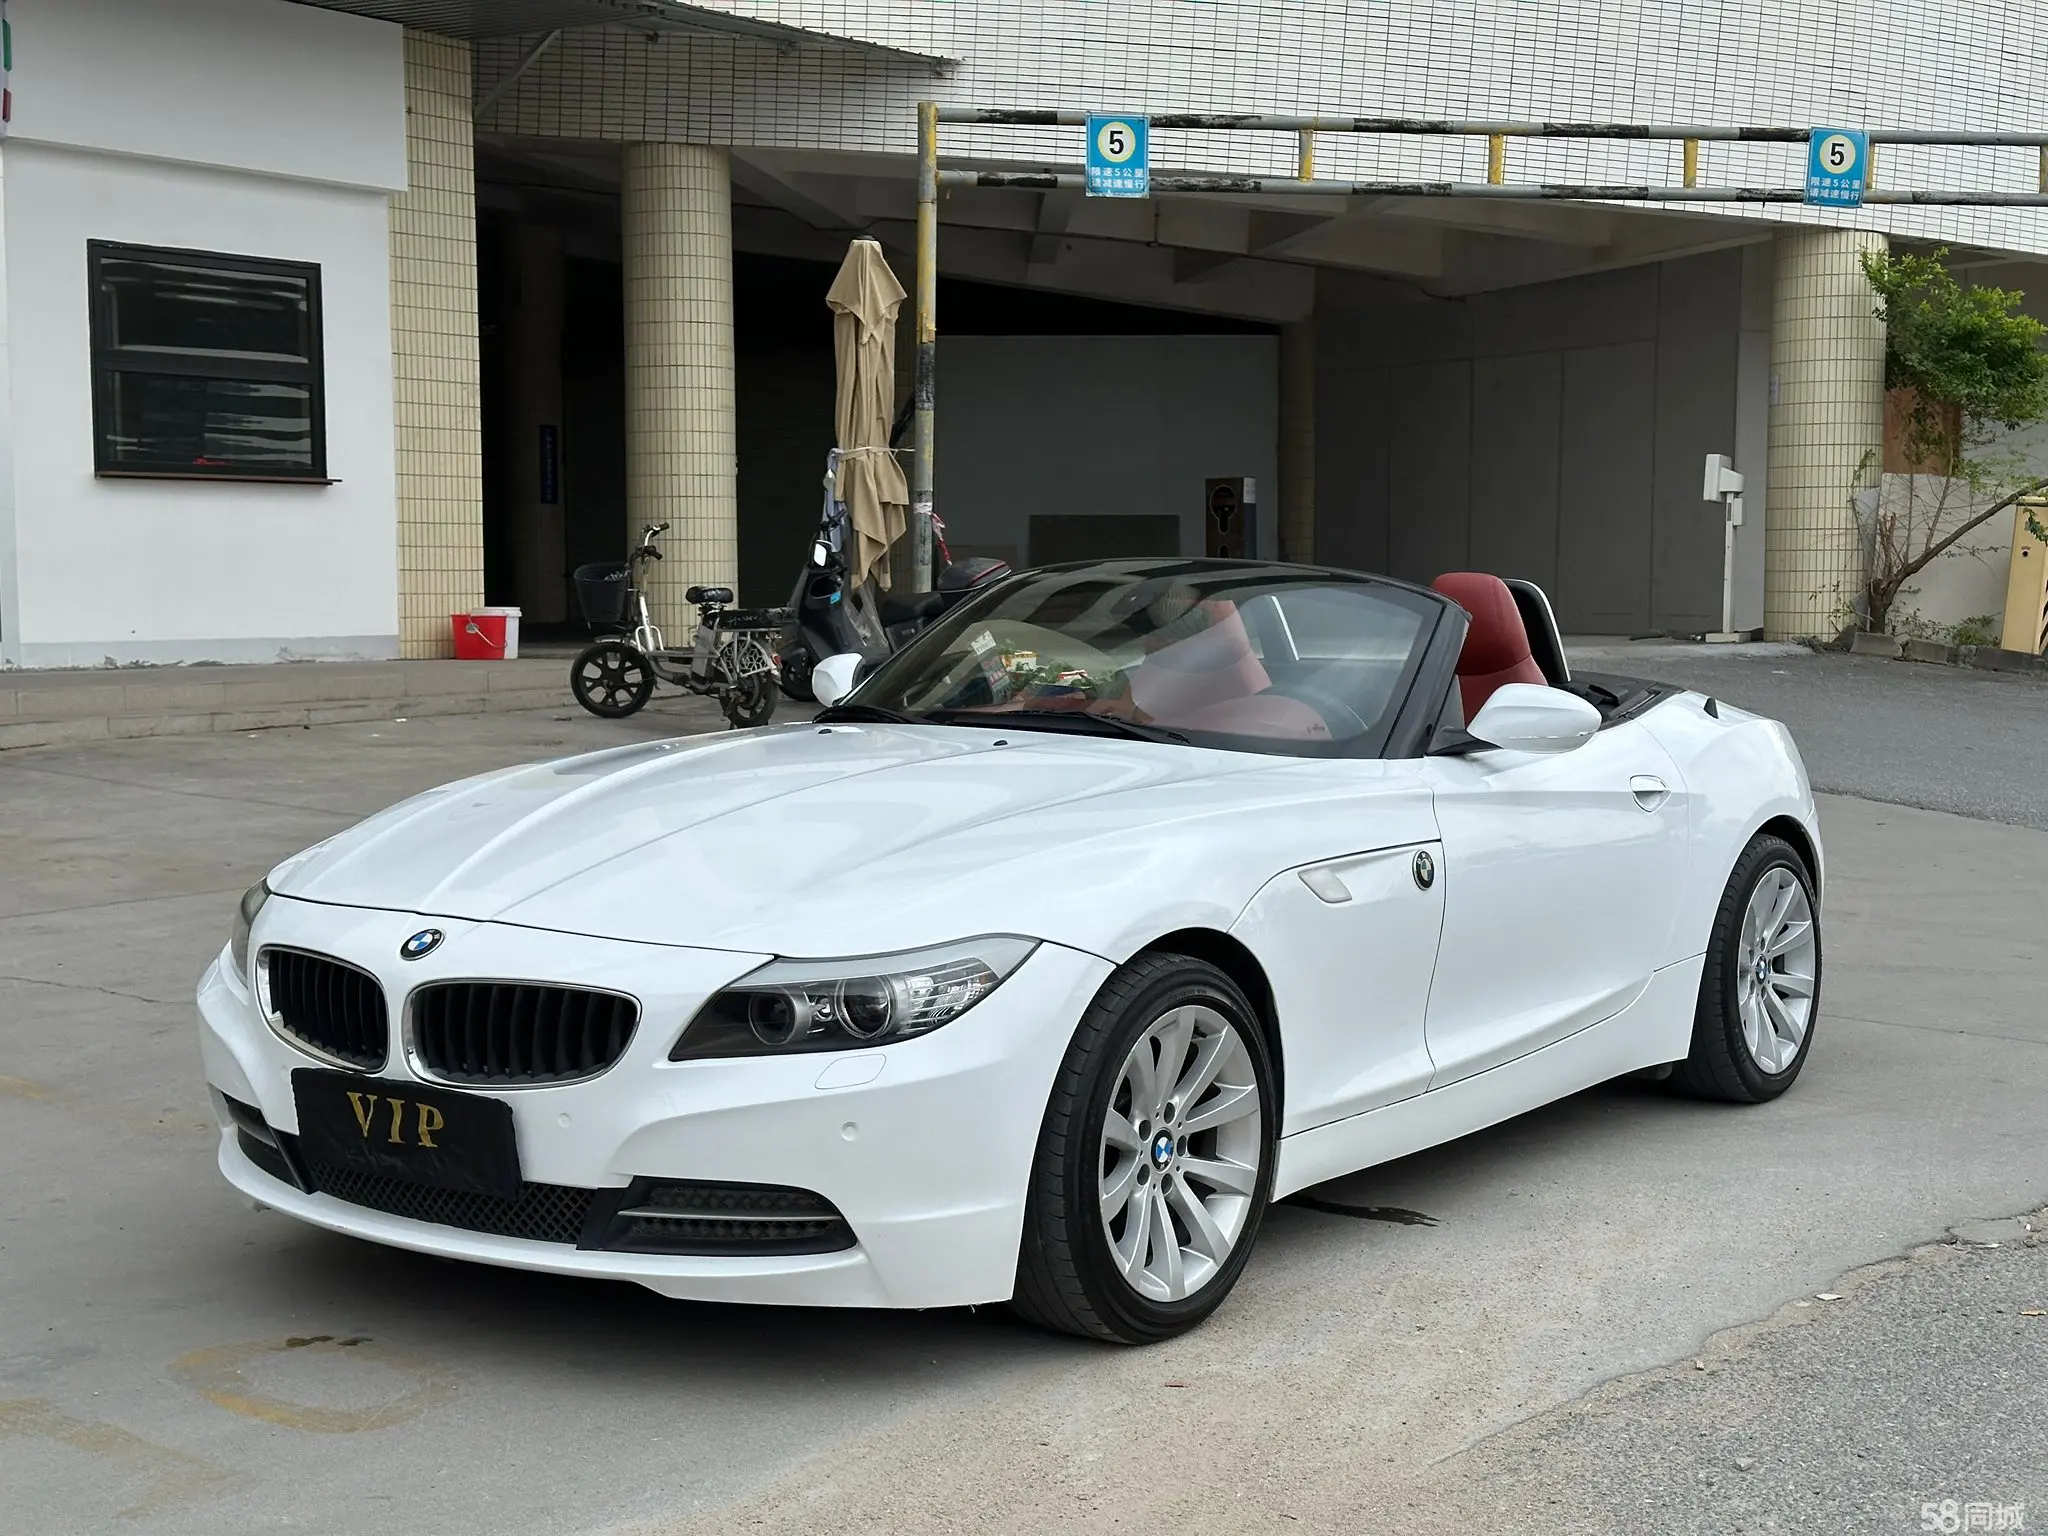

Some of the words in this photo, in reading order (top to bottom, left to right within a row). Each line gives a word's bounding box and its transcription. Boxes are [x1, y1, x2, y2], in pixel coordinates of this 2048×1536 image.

[1109, 130, 1124, 155] 5
[1830, 142, 1845, 166] 5
[346, 1091, 444, 1148] VIP
